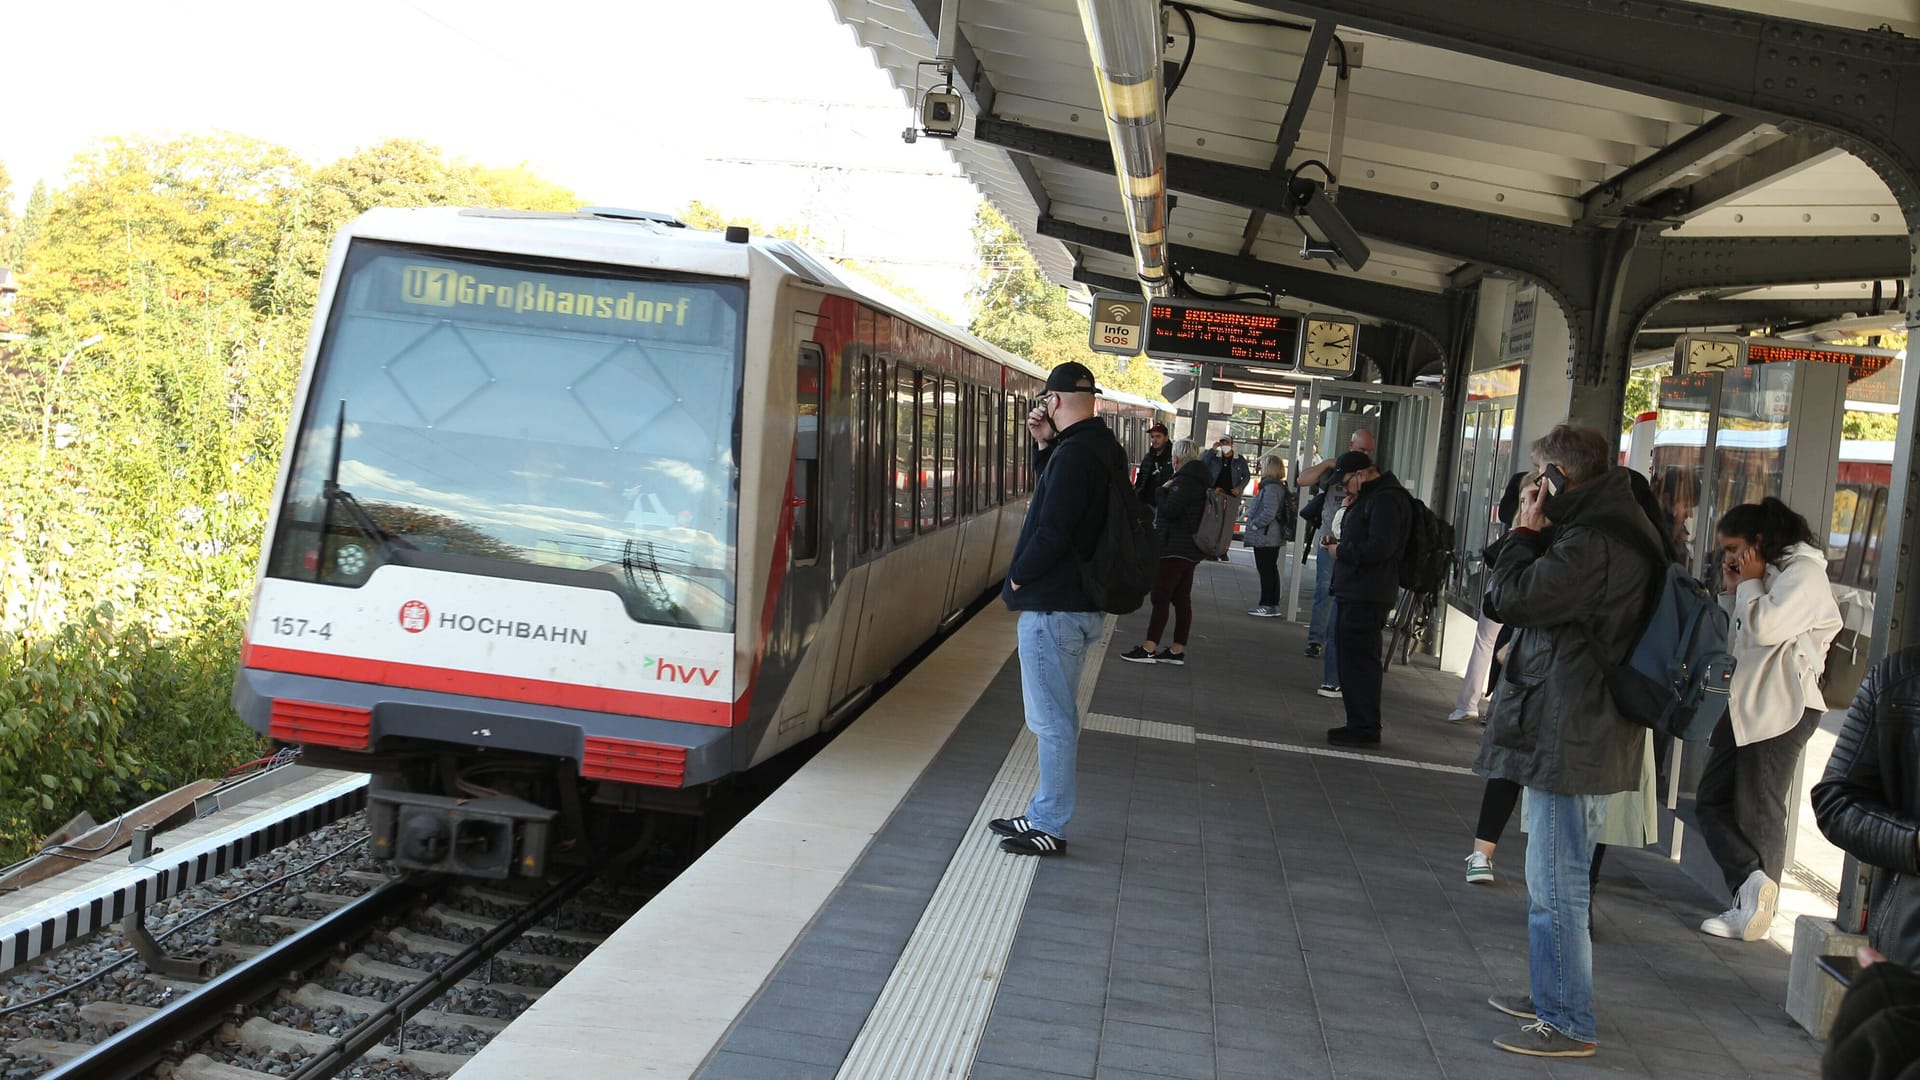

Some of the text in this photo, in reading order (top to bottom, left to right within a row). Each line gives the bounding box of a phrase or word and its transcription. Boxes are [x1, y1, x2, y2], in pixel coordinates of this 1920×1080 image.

[406, 269, 690, 326] U1 Großhansdorf
[1104, 325, 1130, 336] Info
[1185, 309, 1280, 328] GROSSHANSDORF
[1104, 336, 1129, 346] SOS
[271, 616, 332, 641] 157-4
[440, 612, 588, 645] HOCHBAHN
[656, 657, 720, 687] hvv
